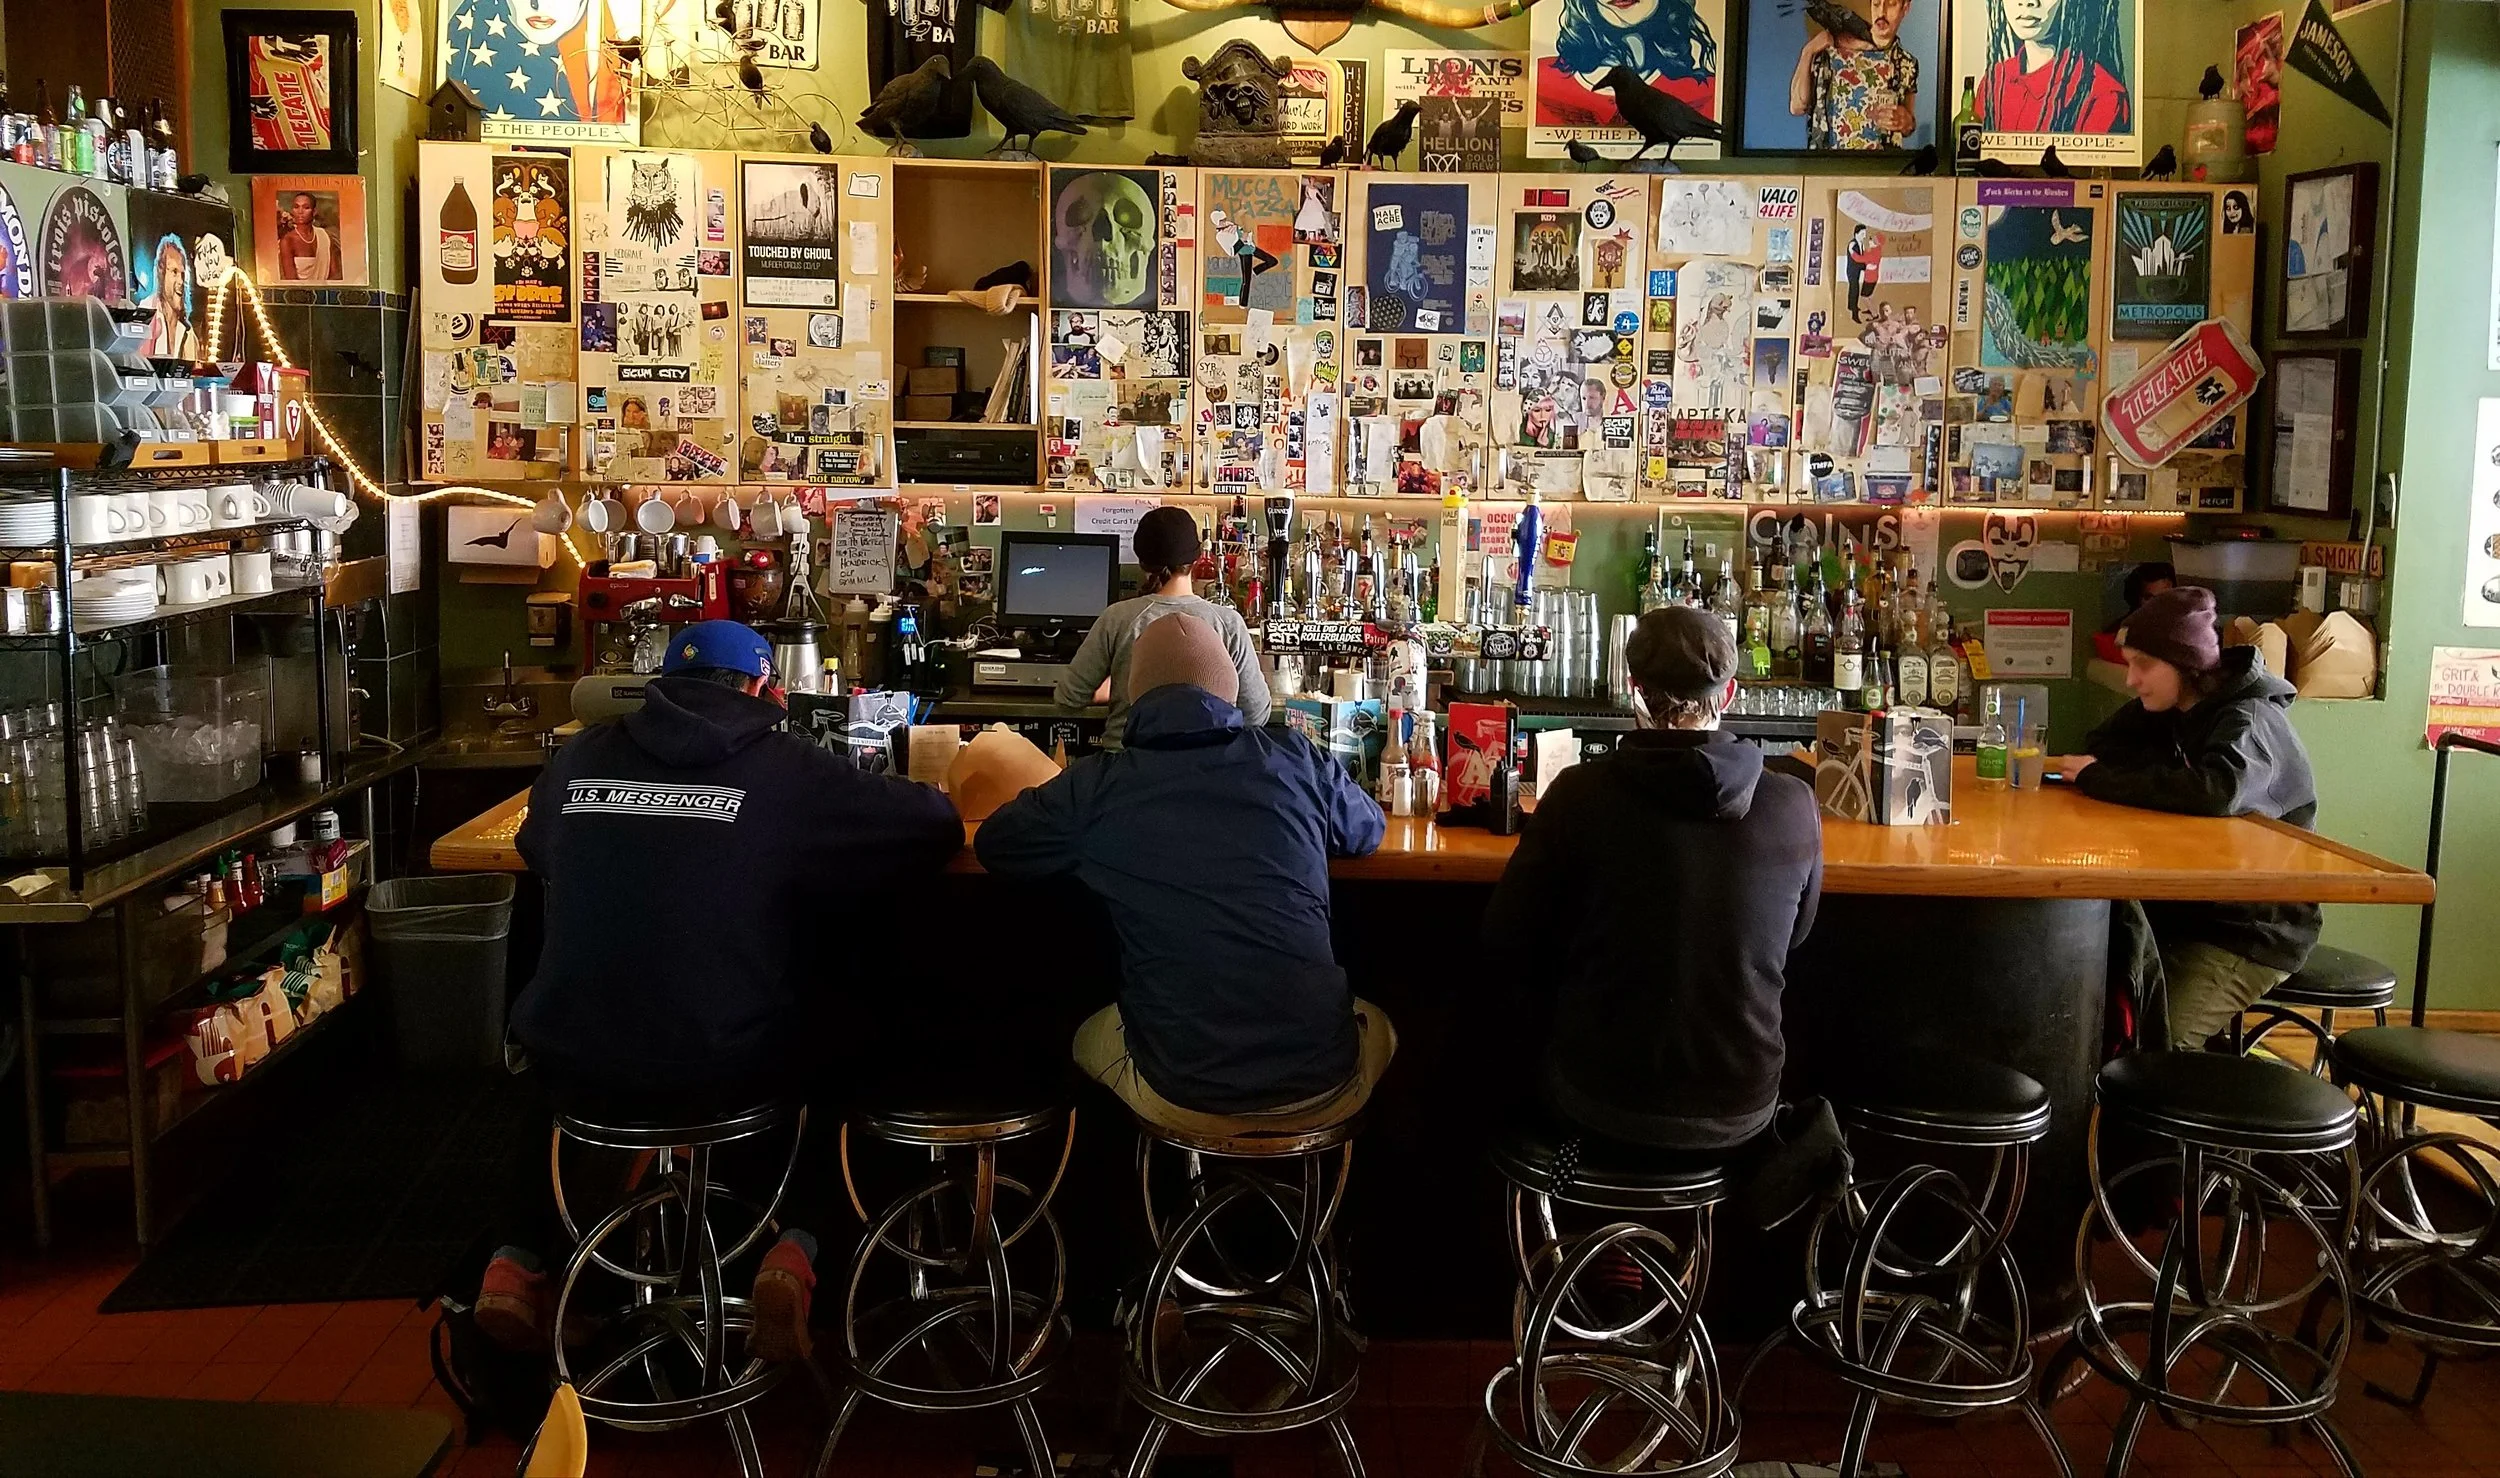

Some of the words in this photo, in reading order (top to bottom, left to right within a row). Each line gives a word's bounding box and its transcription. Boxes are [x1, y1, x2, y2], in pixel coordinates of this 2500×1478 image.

[1086, 19, 1119, 34] BAR
[932, 26, 955, 43] BA
[769, 44, 806, 61] BAR
[2300, 19, 2353, 83] JAMESON
[1401, 57, 1523, 77] LIONS
[1415, 76, 1515, 86] RAPANT
[1478, 90, 1516, 99] THE
[274, 71, 320, 150] TECATE
[1344, 66, 1354, 157] HIDEOUT
[500, 124, 535, 135] THE
[542, 124, 609, 138] PEOPLE
[1301, 122, 1322, 131] WORK
[1554, 129, 1582, 140] WE
[1587, 130, 1622, 140] THE
[1423, 137, 1493, 151] HELLION
[1981, 136, 2006, 145] WE
[2012, 136, 2045, 146] THE
[2051, 136, 2115, 148] PEOPLE
[1466, 153, 1494, 162] COLD
[1465, 162, 1495, 170] BREW
[1212, 175, 1283, 200] MUCCA
[1761, 188, 1798, 204] VALO
[1375, 208, 1400, 219] HALF
[1759, 204, 1797, 217] 4LIFE
[1376, 215, 1401, 225] ACRE
[748, 246, 789, 258] TOUCHED
[790, 247, 802, 258] BY
[804, 247, 833, 260] GHOUL
[2119, 306, 2203, 318] METROPOLIS
[621, 367, 652, 379] SCUM
[658, 368, 688, 379] CITY
[2121, 339, 2209, 424] TECATE
[1611, 387, 1638, 416] A
[1676, 408, 1748, 424] APTEKA
[1604, 418, 1631, 428] SCUM
[786, 432, 805, 443] I'm
[808, 432, 851, 445] straight
[1602, 427, 1631, 437] CITY
[809, 474, 828, 483] not
[1102, 506, 1134, 515] Forgotten
[1750, 509, 1899, 557] COINS
[1302, 624, 1321, 632] KELL
[1350, 625, 1362, 633] ON
[1364, 634, 1389, 645] Patrol
[2442, 668, 2469, 681] GRIT
[2471, 670, 2479, 682] &
[2448, 683, 2490, 697] DOUBLE
[571, 789, 600, 803] U.S.
[605, 789, 742, 813] MESSENGER
